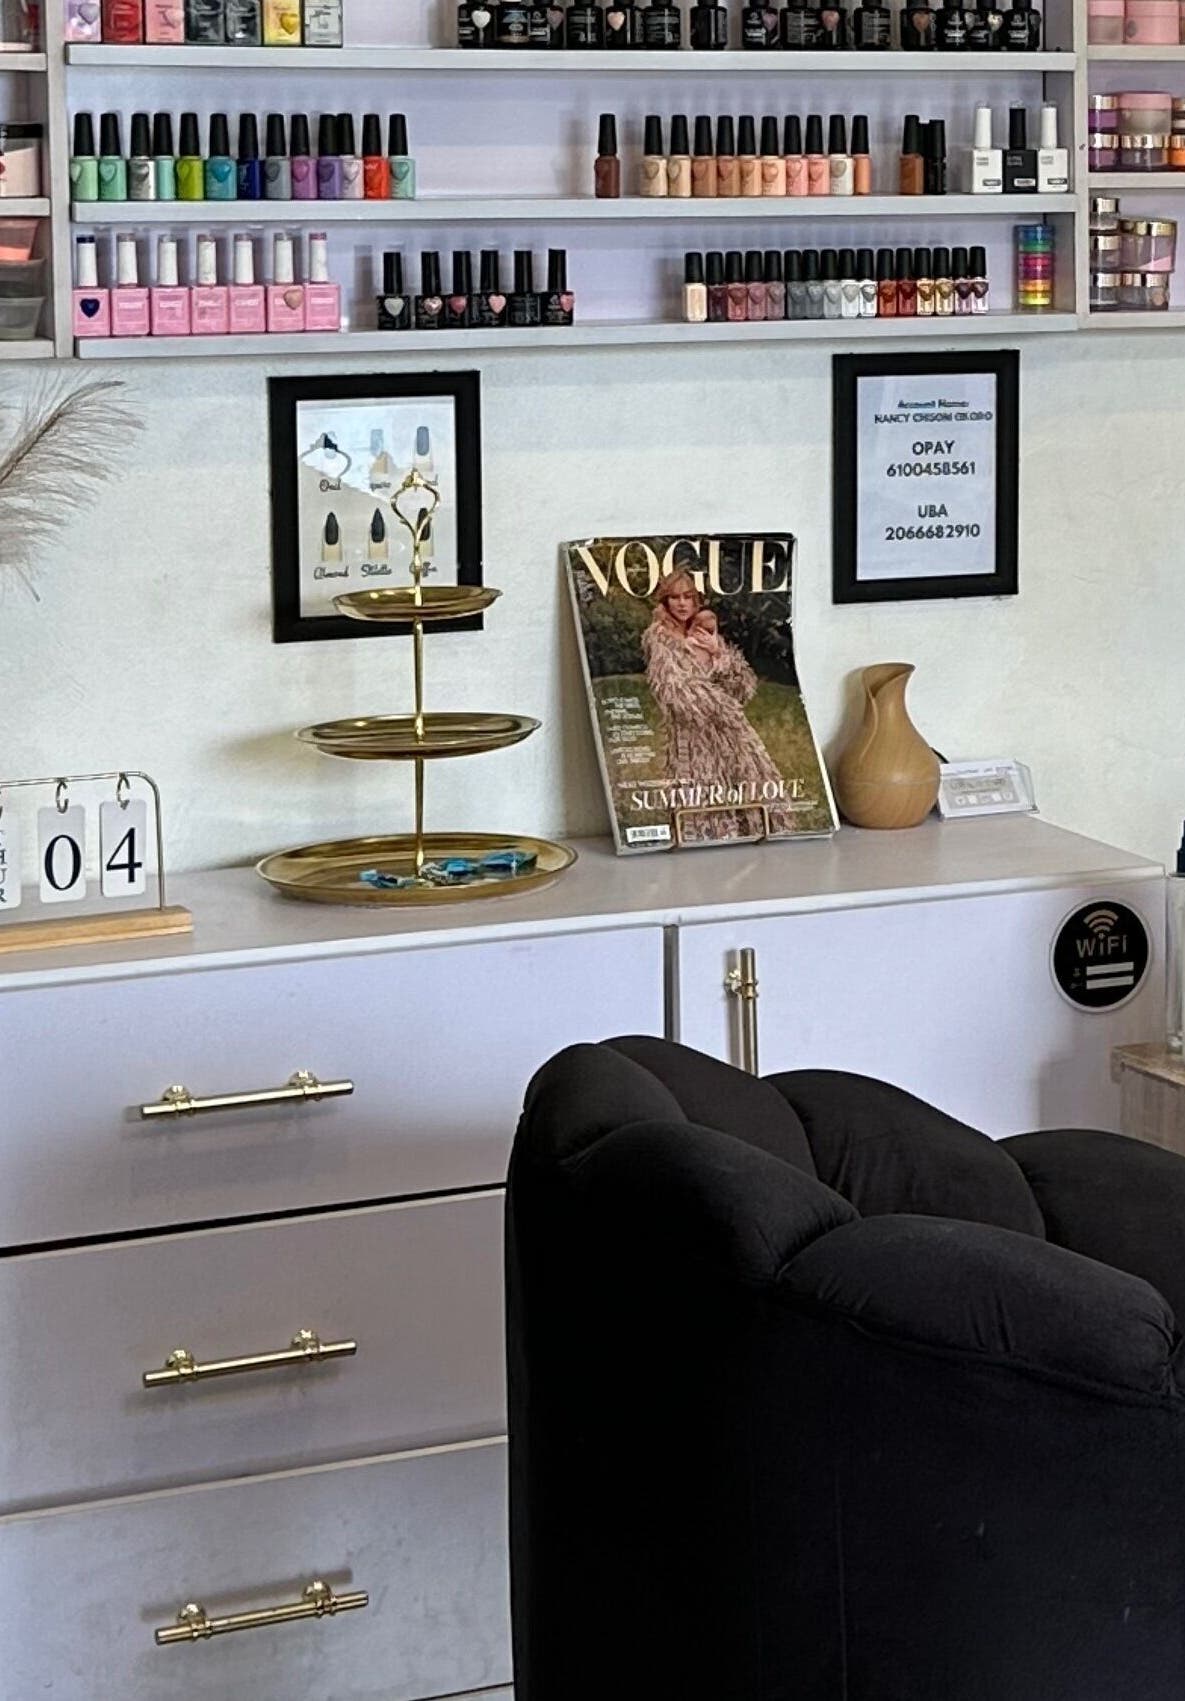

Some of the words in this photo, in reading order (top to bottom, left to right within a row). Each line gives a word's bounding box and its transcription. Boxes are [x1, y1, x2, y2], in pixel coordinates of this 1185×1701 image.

[912, 440, 955, 455] OPAY
[887, 461, 976, 477] 6100458561
[918, 504, 949, 518] UBA
[571, 539, 789, 598] VOGUE
[727, 781, 747, 805] of
[750, 779, 804, 802] LOVE
